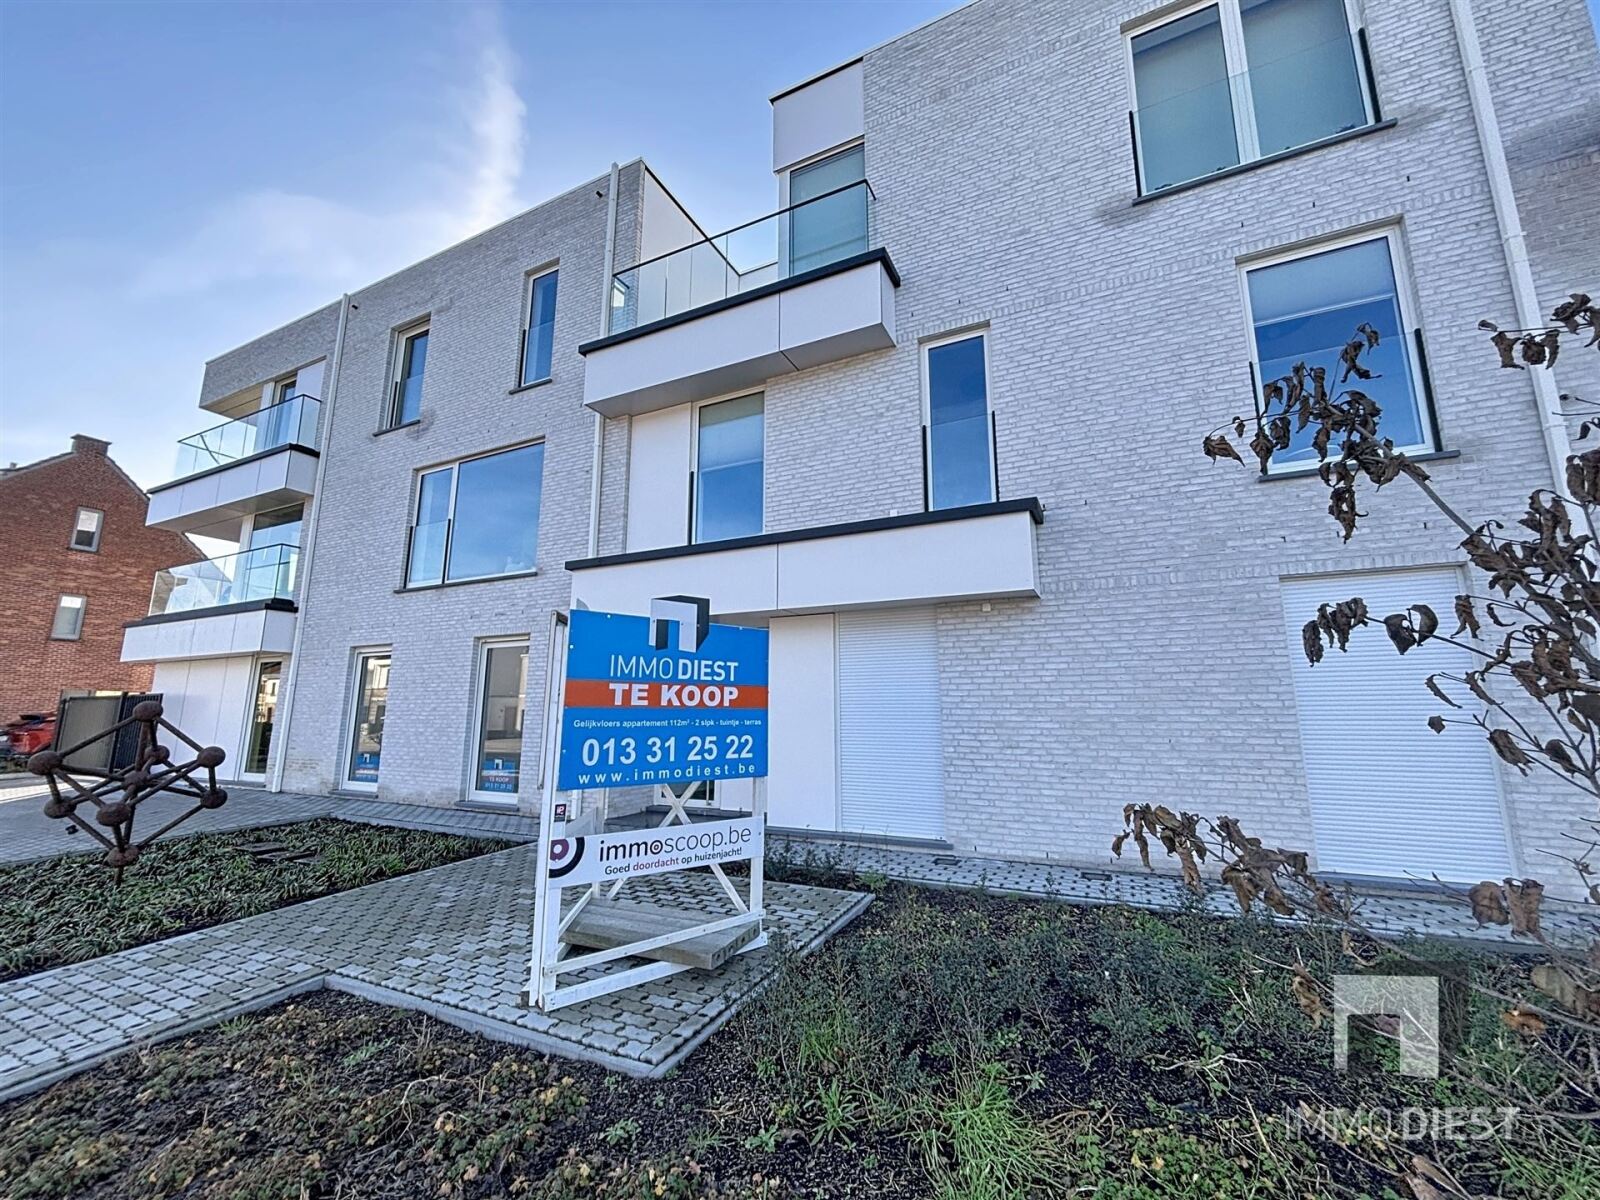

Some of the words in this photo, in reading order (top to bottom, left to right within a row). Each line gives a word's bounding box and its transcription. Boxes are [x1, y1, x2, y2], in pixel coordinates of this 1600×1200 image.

[610, 654, 673, 680] IMMO
[677, 658, 739, 682] DIEST
[609, 683, 649, 706] TE
[660, 684, 739, 707] KOOP
[573, 719, 620, 729] Gelijkvloers
[622, 719, 668, 728] appartement
[582, 737, 636, 767] 013
[646, 736, 676, 764] 31
[687, 735, 718, 761] 25
[725, 734, 753, 759] 22
[578, 762, 755, 785] www.immodiest.be
[599, 826, 751, 862] immoscoop.be
[604, 862, 631, 875] Goed
[632, 857, 680, 872] doordacht
[681, 855, 693, 866] op
[694, 847, 742, 863] huizenjacht!
